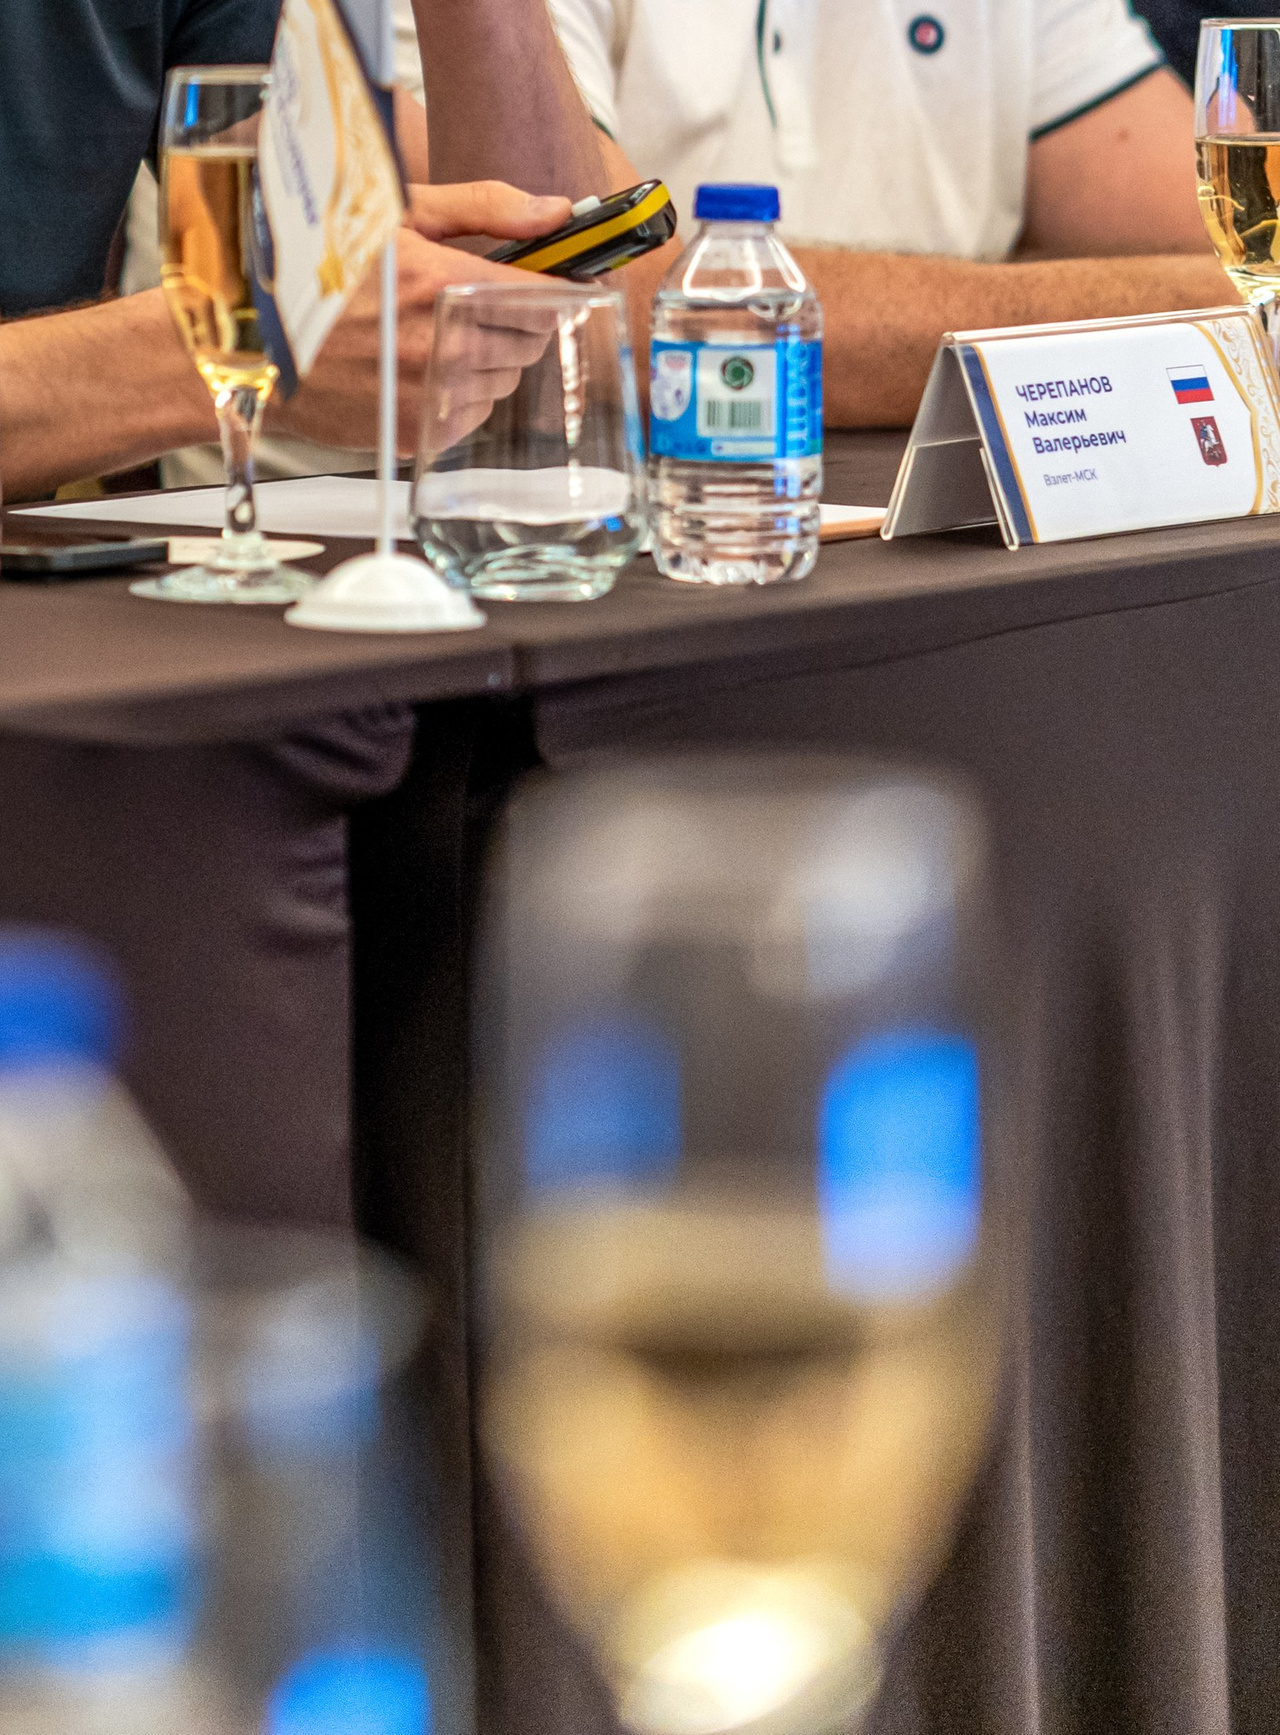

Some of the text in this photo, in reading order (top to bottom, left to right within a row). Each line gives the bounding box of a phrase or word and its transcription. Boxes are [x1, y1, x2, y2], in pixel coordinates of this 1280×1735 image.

[1015, 376, 1113, 402] ЧЕРЕПАНОВ
[1024, 409, 1087, 428] Максим
[1032, 430, 1127, 454] Валерьевич
[1043, 469, 1098, 486] Взлет-МСК
